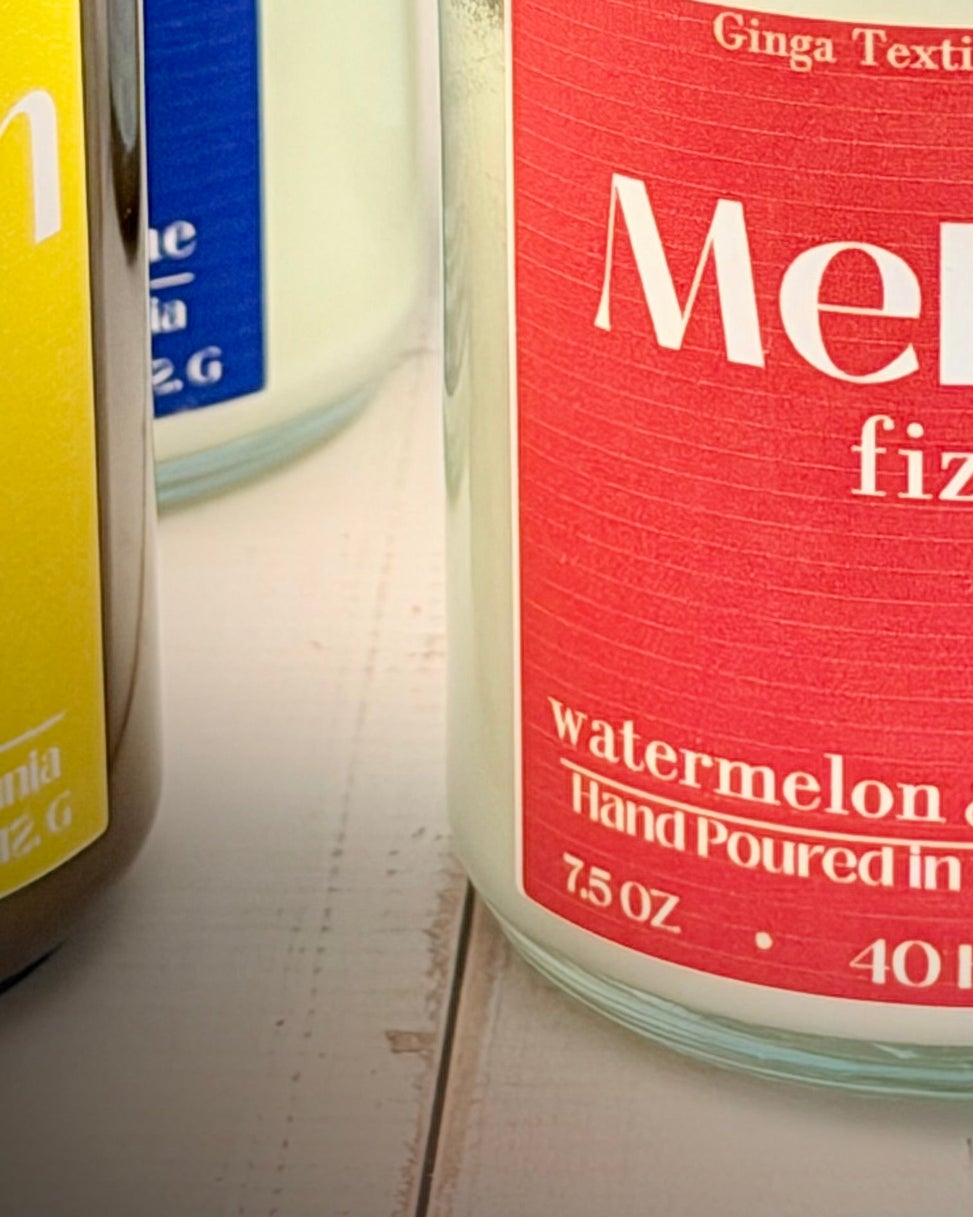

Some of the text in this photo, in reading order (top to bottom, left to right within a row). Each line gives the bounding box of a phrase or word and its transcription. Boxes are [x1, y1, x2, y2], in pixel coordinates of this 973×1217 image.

[713, 11, 836, 73] Ginga
[186, 345, 223, 385] G
[0, 747, 62, 809] nia
[547, 696, 946, 824] watermelon
[571, 772, 686, 852] Hand
[697, 815, 894, 888] Poured
[908, 845, 961, 892] in
[562, 852, 613, 908] 7.5
[620, 880, 682, 934] OZ
[849, 938, 941, 989] 40
